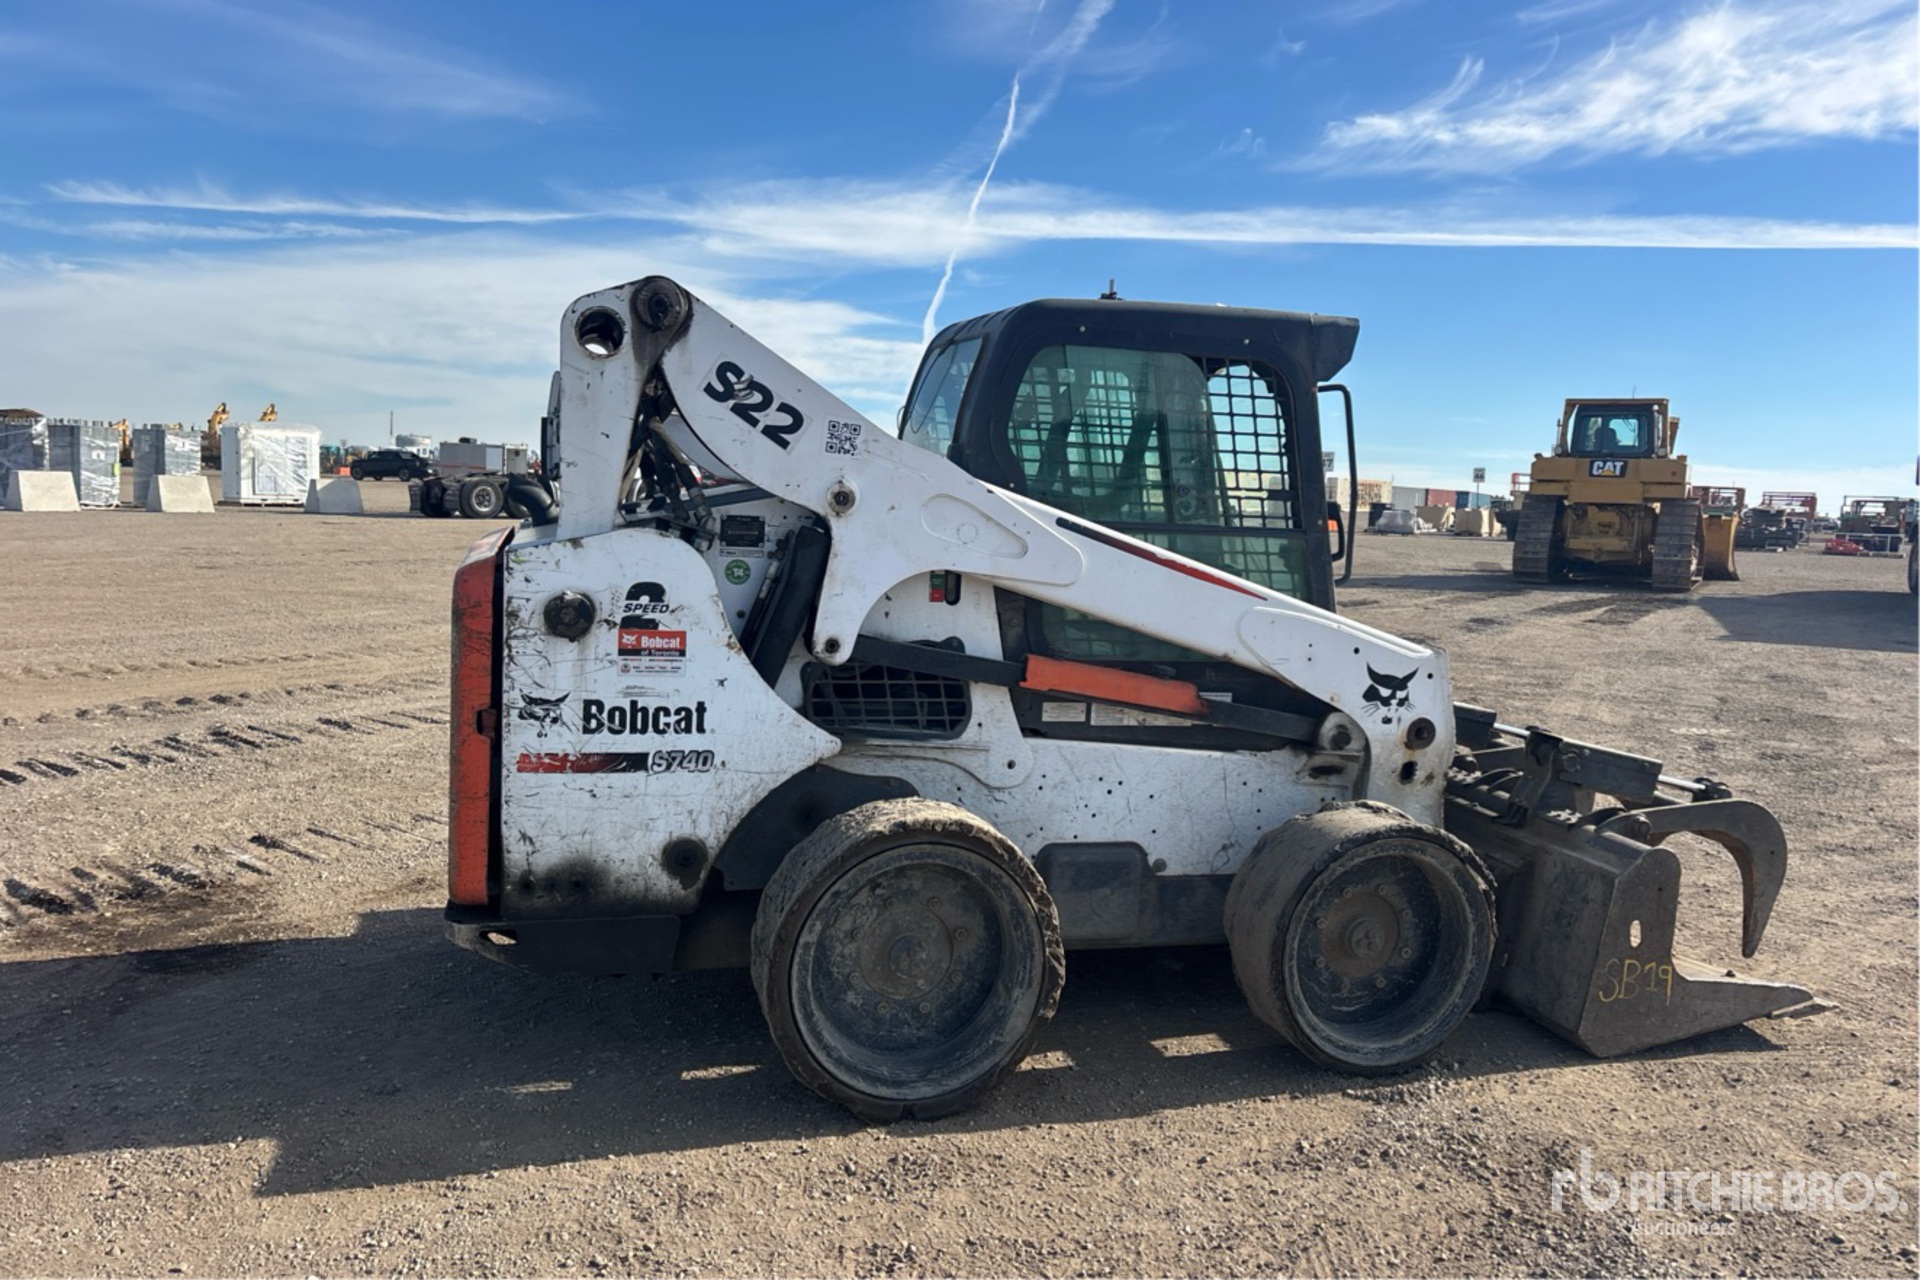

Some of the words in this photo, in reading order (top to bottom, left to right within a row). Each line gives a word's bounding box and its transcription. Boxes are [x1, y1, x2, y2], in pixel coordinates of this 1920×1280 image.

[703, 361, 804, 450] S22
[1592, 461, 1624, 476] CAT
[622, 603, 670, 614] SPEED
[641, 635, 680, 648] Bobcat
[582, 699, 707, 735] Bobcat
[651, 750, 715, 773] S740
[1599, 958, 1673, 1006] SB19
